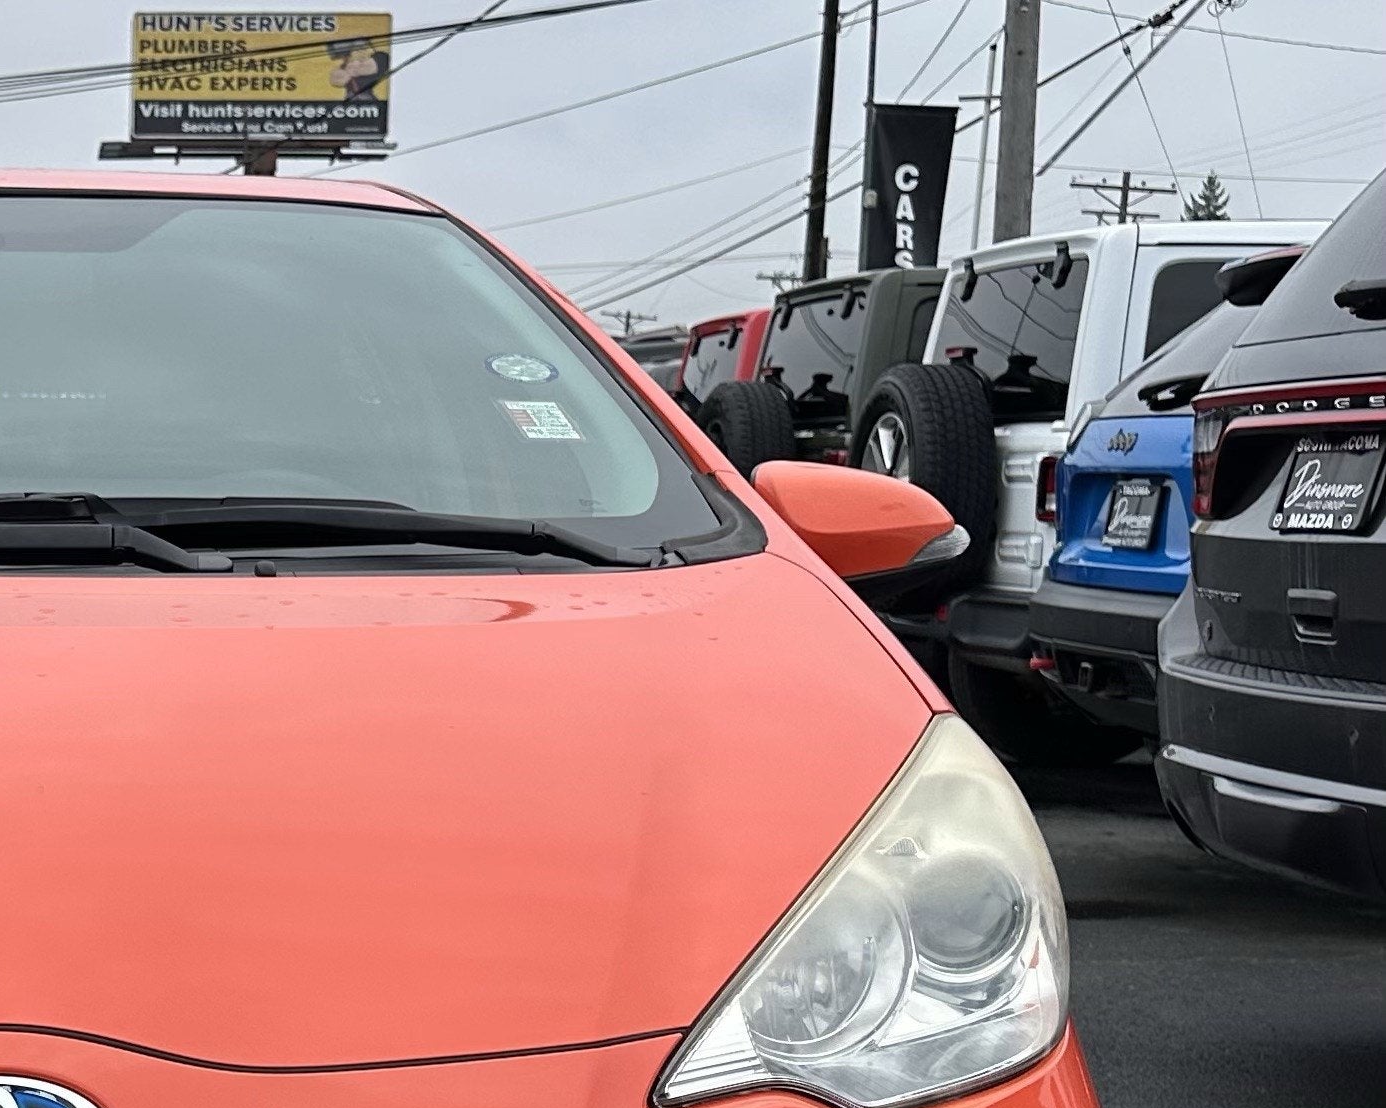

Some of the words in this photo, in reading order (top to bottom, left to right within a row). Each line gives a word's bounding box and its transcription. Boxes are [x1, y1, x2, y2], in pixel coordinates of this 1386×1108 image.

[141, 16, 225, 32] HUNT'S
[232, 16, 336, 32] SERVICES
[139, 39, 247, 54] PLUMBERS
[138, 77, 202, 91] HVAC
[210, 77, 297, 91] EXPERTS
[139, 103, 183, 118] Visit
[181, 121, 233, 134] Service
[296, 121, 329, 134] Tust
[894, 163, 920, 269] CARS
[1252, 395, 1386, 415] DODGE
[1287, 513, 1334, 529] MAZDA
